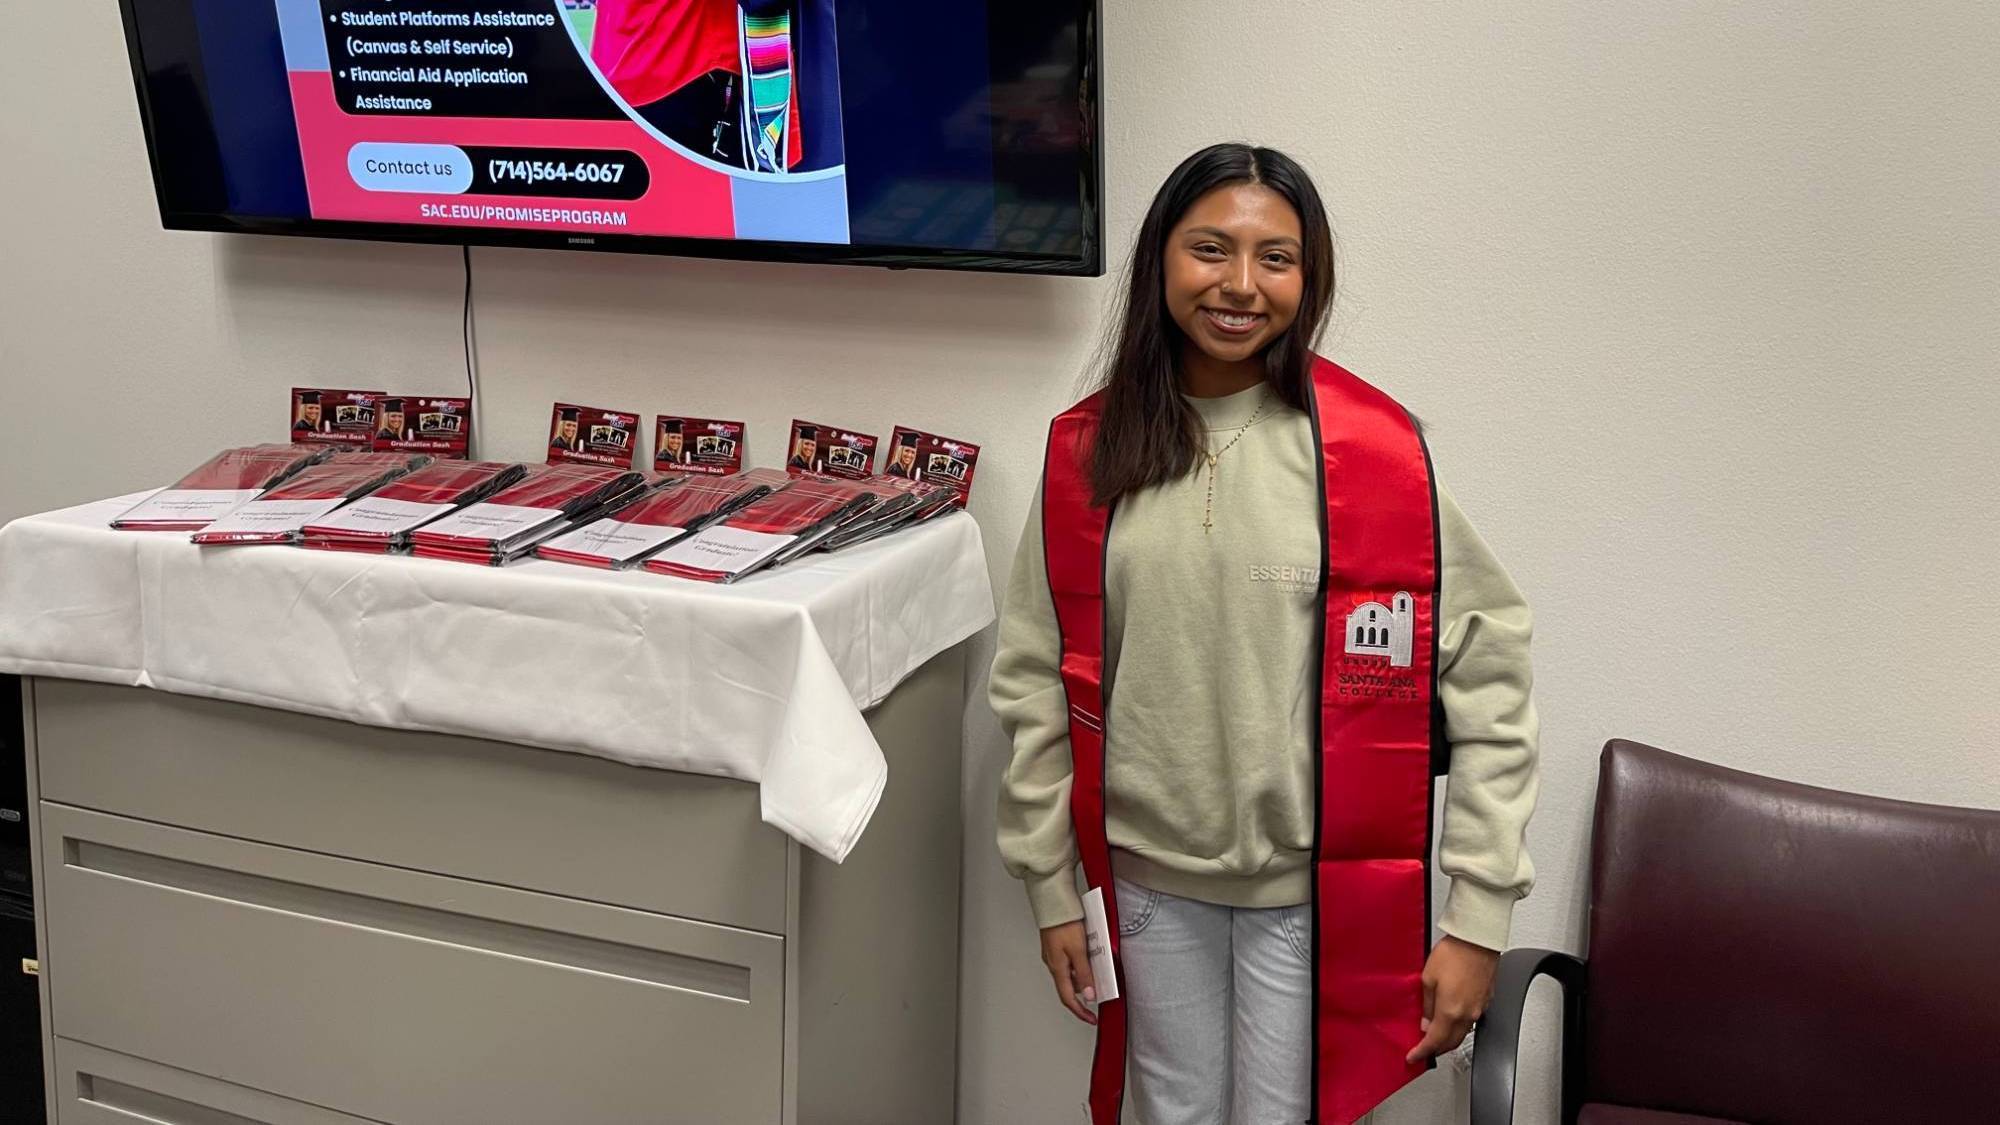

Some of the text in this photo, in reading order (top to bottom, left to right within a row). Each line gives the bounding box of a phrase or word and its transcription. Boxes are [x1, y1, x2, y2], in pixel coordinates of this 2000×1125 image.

[341, 11, 555, 26] Student Platforms Assistance
[347, 36, 514, 58] (Canvas & Self Service)
[350, 66, 528, 87] Financial Aid Application
[355, 94, 432, 110] Assistance
[366, 159, 452, 176] Contact us
[488, 159, 624, 184] (714)564-6067
[420, 203, 628, 226] SAC.EDU/PROMISEPROGRAM
[562, 450, 598, 462] Graduation
[669, 463, 725, 475] Graduation Sash
[1339, 673, 1384, 686] SANTA
